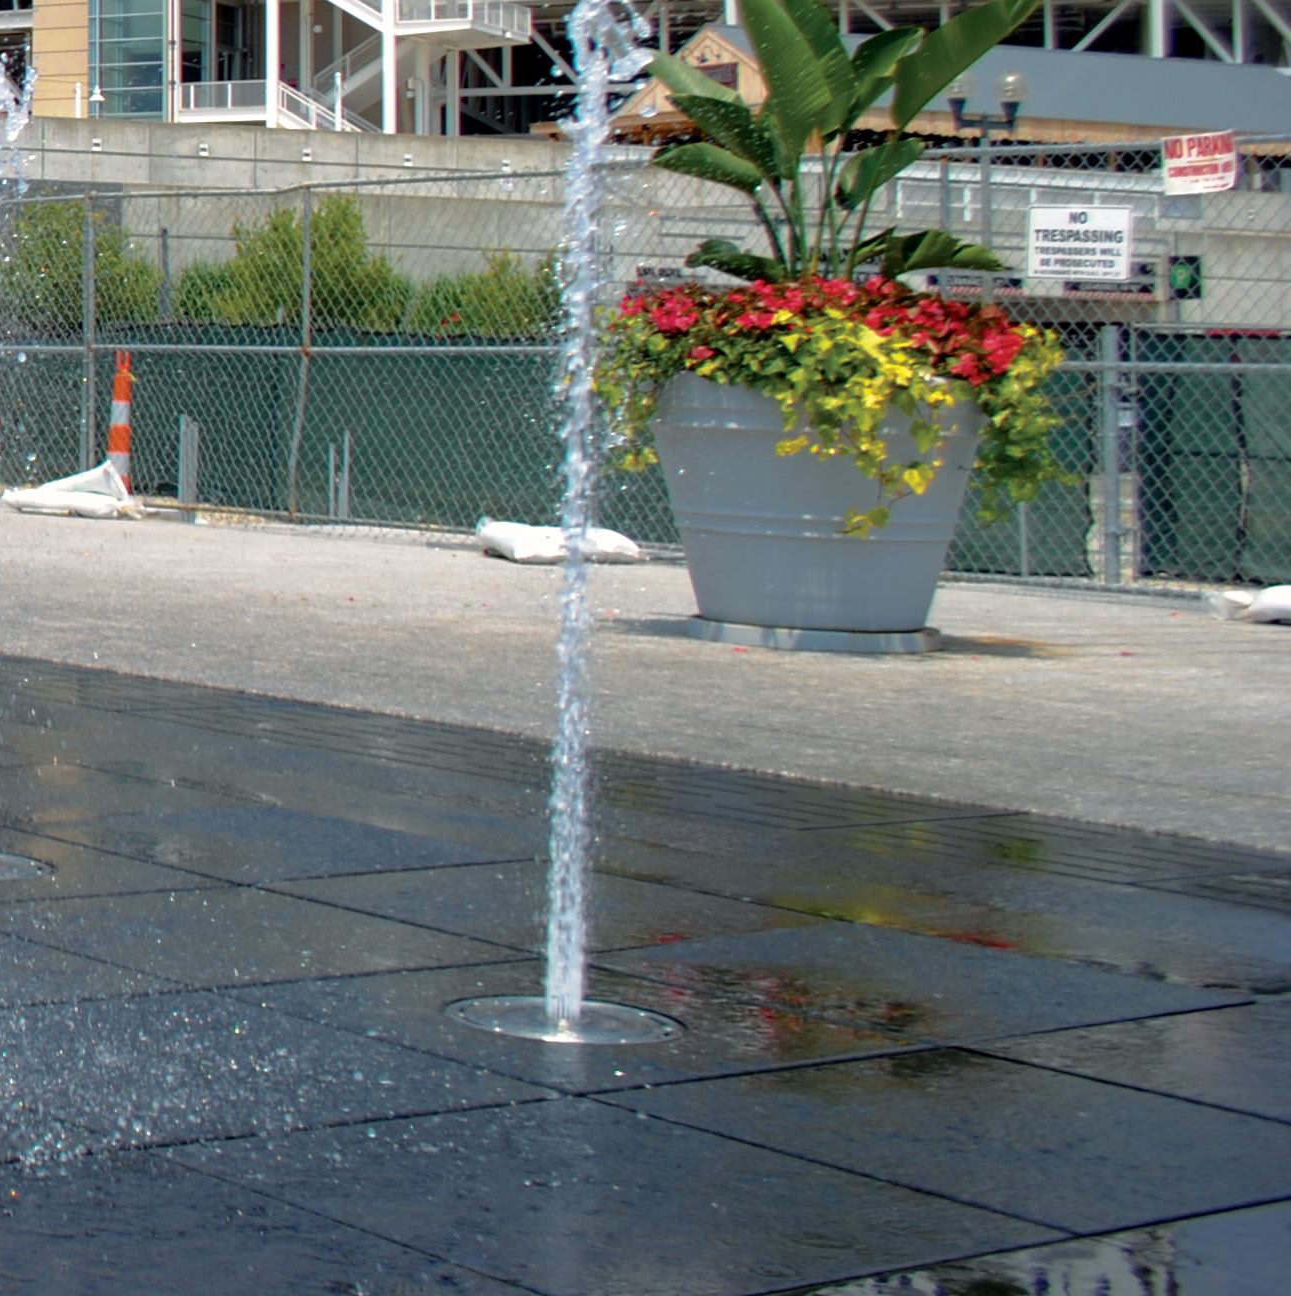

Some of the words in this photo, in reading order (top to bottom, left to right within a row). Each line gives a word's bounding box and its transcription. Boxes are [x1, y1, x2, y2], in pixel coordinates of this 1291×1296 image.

[1163, 138, 1183, 159] NO
[1069, 211, 1088, 224] NO
[1034, 228, 1124, 243] TRESPASSING
[1035, 246, 1097, 255] TRESPASSERS
[1100, 248, 1121, 257] WILL
[1040, 258, 1052, 267] BE
[1054, 258, 1115, 268] PROSECUTED
